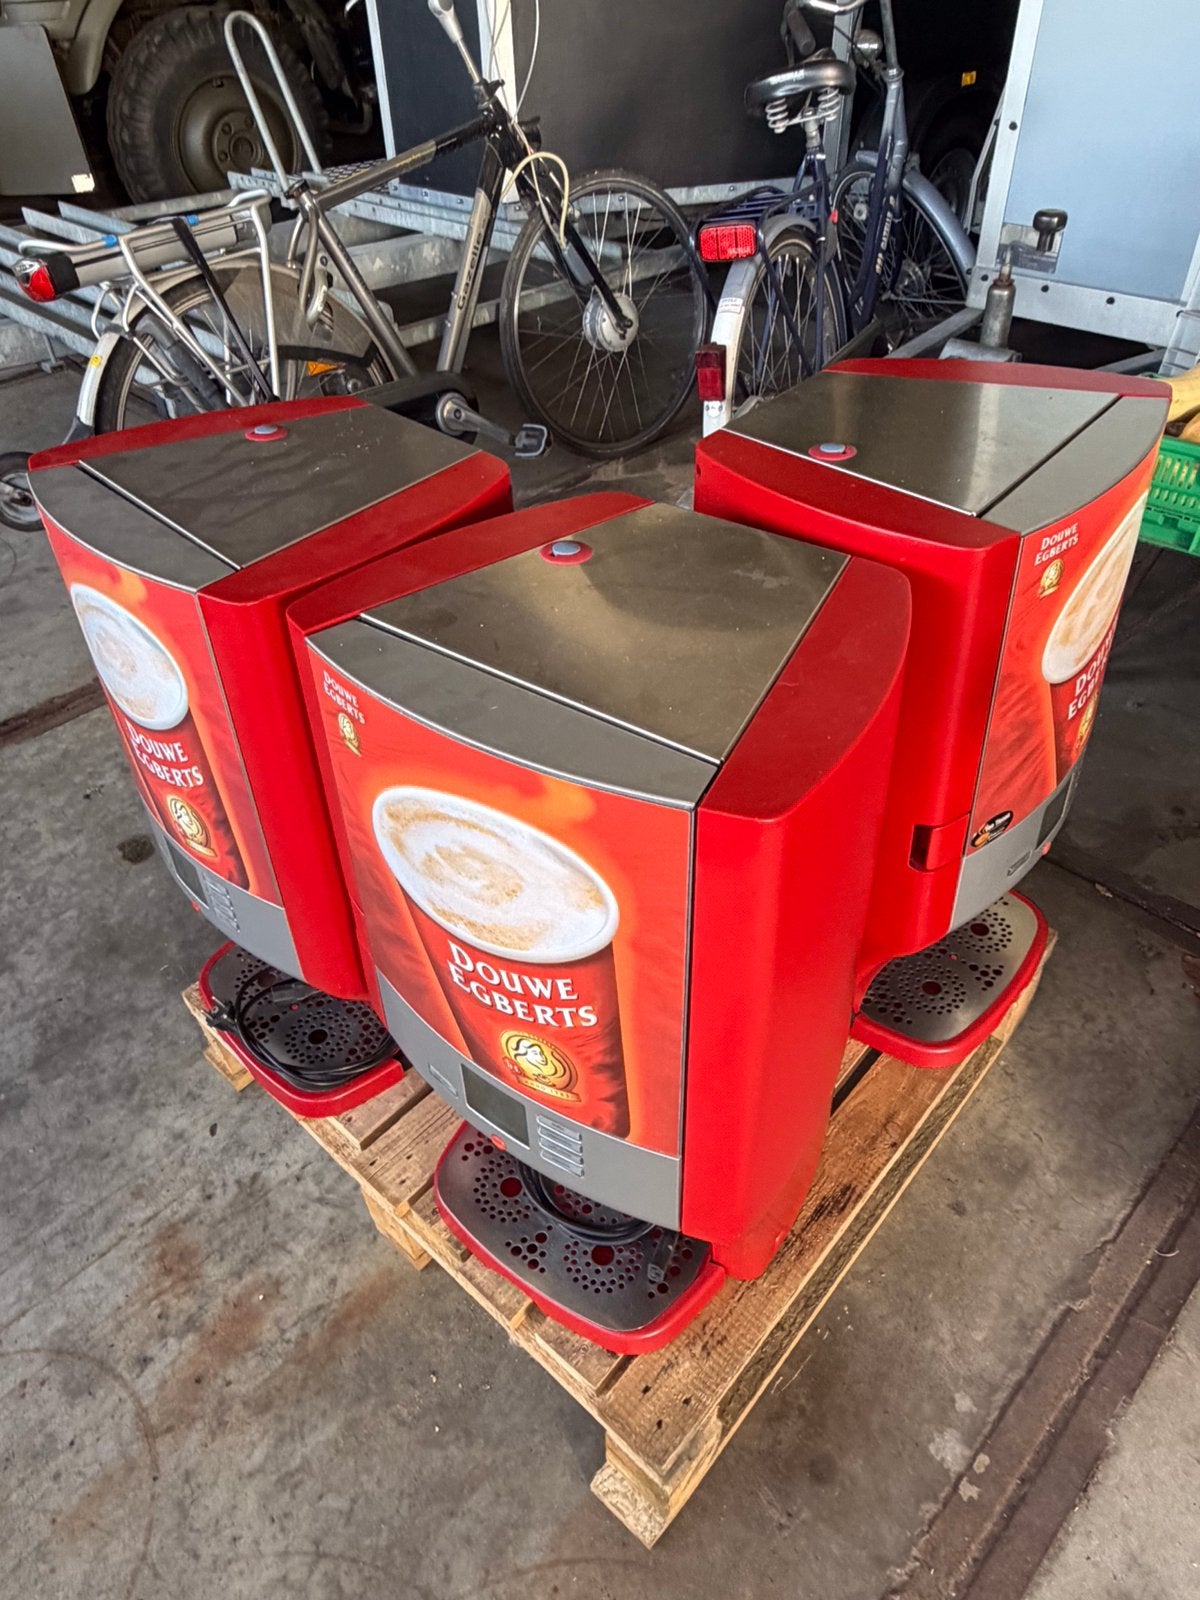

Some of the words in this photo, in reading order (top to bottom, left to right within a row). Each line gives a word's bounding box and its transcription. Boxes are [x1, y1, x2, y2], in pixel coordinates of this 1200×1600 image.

[457, 233, 482, 309] Gazelle
[1034, 533, 1079, 567] EGBERTS
[1040, 522, 1079, 551] DOUWE
[323, 669, 359, 709] DOUWE
[323, 681, 366, 725] EGBERTS
[124, 718, 188, 763] DOUWE
[130, 738, 204, 788] EGBERTS
[447, 939, 579, 1001] DOUWE
[447, 960, 599, 1029] EGBERTS
